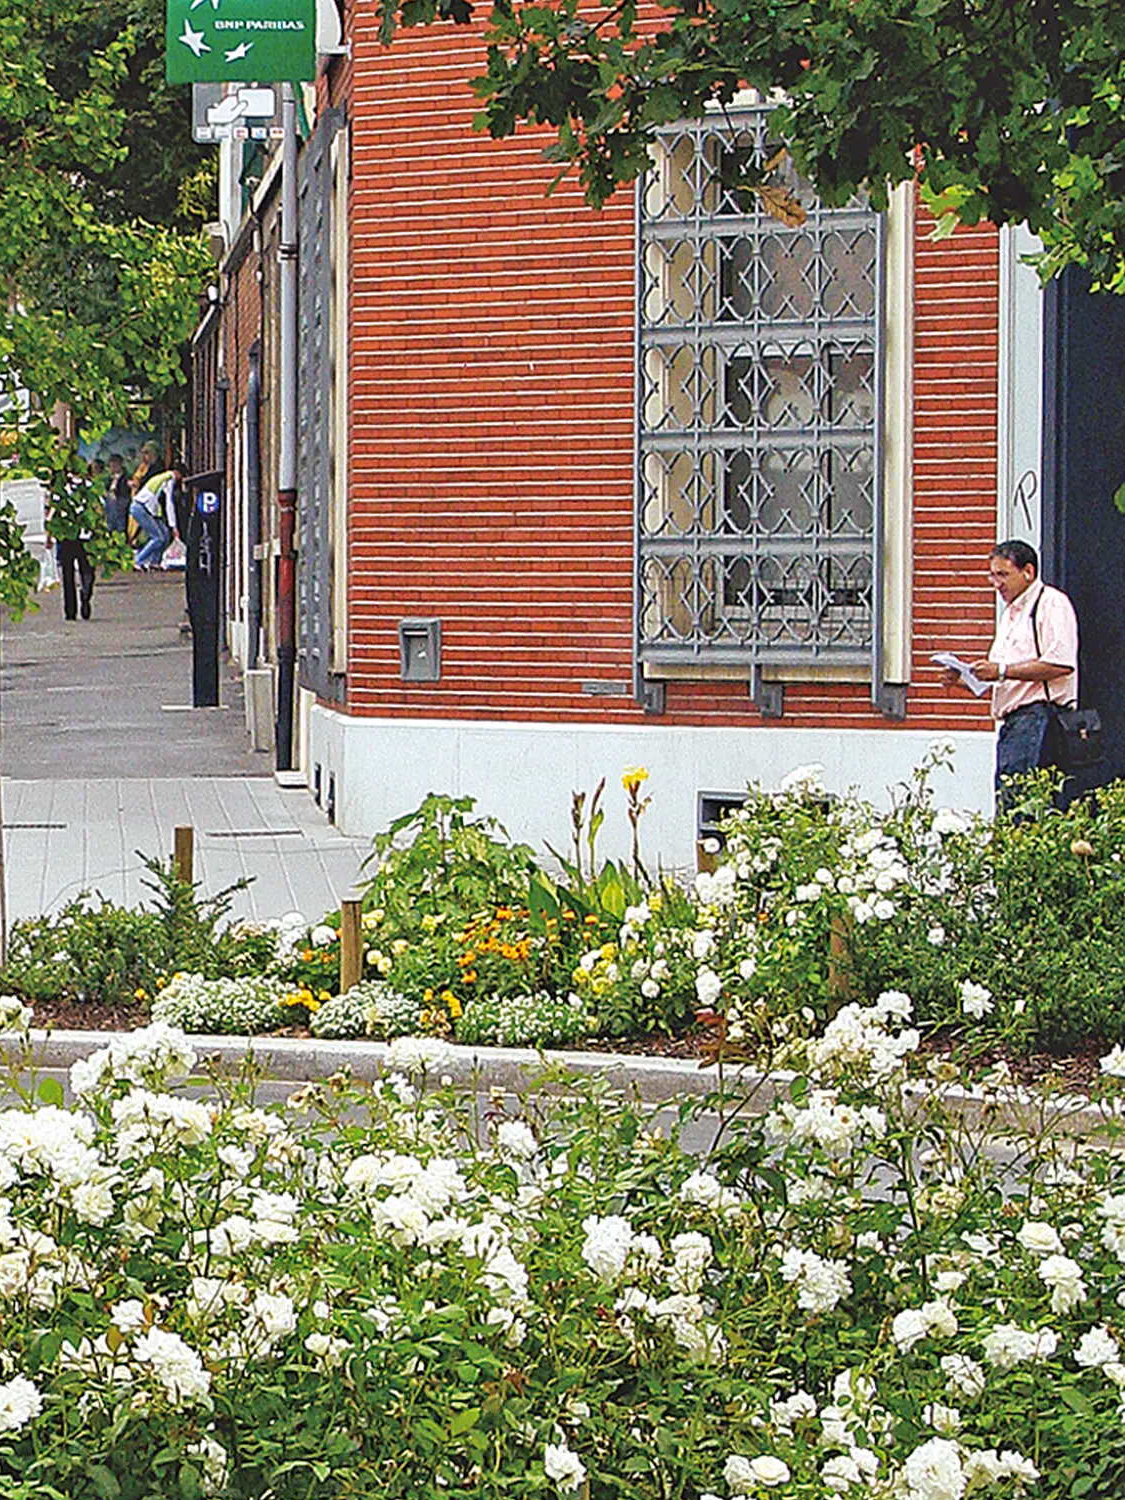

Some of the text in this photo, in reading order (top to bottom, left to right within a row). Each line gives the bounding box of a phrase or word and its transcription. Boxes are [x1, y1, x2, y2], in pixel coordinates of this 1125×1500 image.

[214, 20, 305, 30] BNP PARIBAS
[203, 492, 217, 512] P
